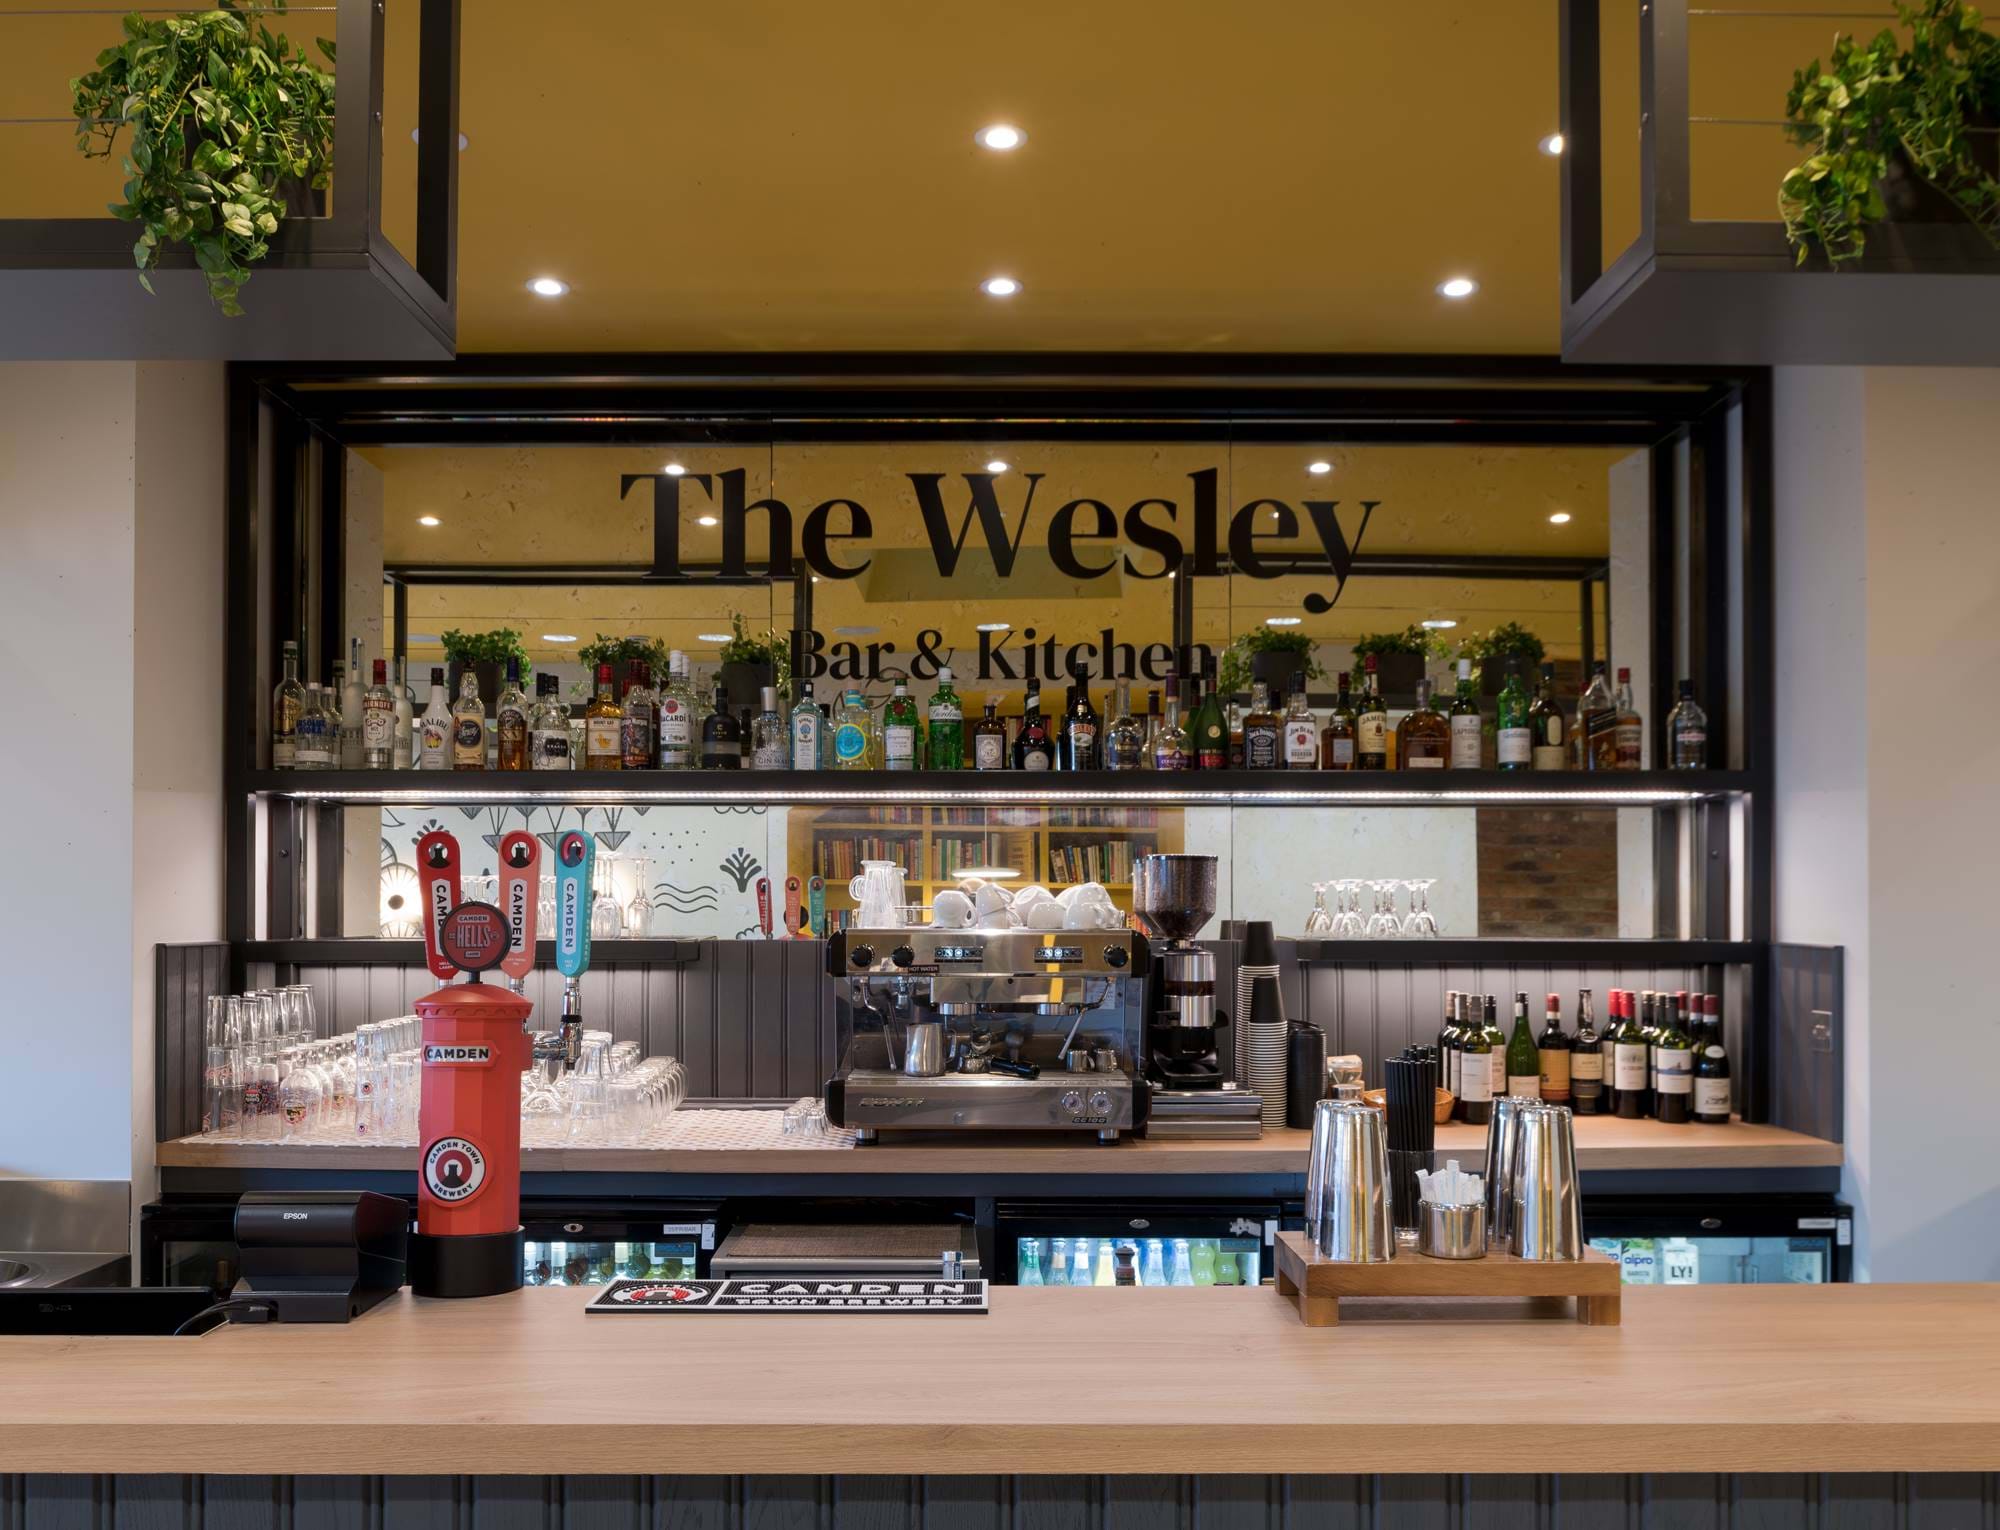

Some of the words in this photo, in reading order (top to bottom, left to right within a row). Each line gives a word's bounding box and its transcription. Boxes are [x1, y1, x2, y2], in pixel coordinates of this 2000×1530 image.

[620, 467, 873, 581] The
[904, 466, 1382, 614] Wesley
[791, 628, 895, 682] Bar
[911, 629, 960, 682] &
[976, 626, 1214, 682] Kitchen
[419, 718, 449, 730] MALIBU
[435, 884, 448, 928] CAMD
[511, 884, 524, 947] CAMDEN
[564, 883, 575, 948] CAMDEN
[456, 924, 491, 948] HELLS
[427, 1048, 489, 1059] CAMDEN
[430, 1142, 459, 1164] CAMDEN
[461, 1143, 481, 1165] TOWN
[433, 1183, 474, 1197] BREWERY
[1624, 1254, 1654, 1267] alpro
[740, 1283, 964, 1295] CAMDEN
